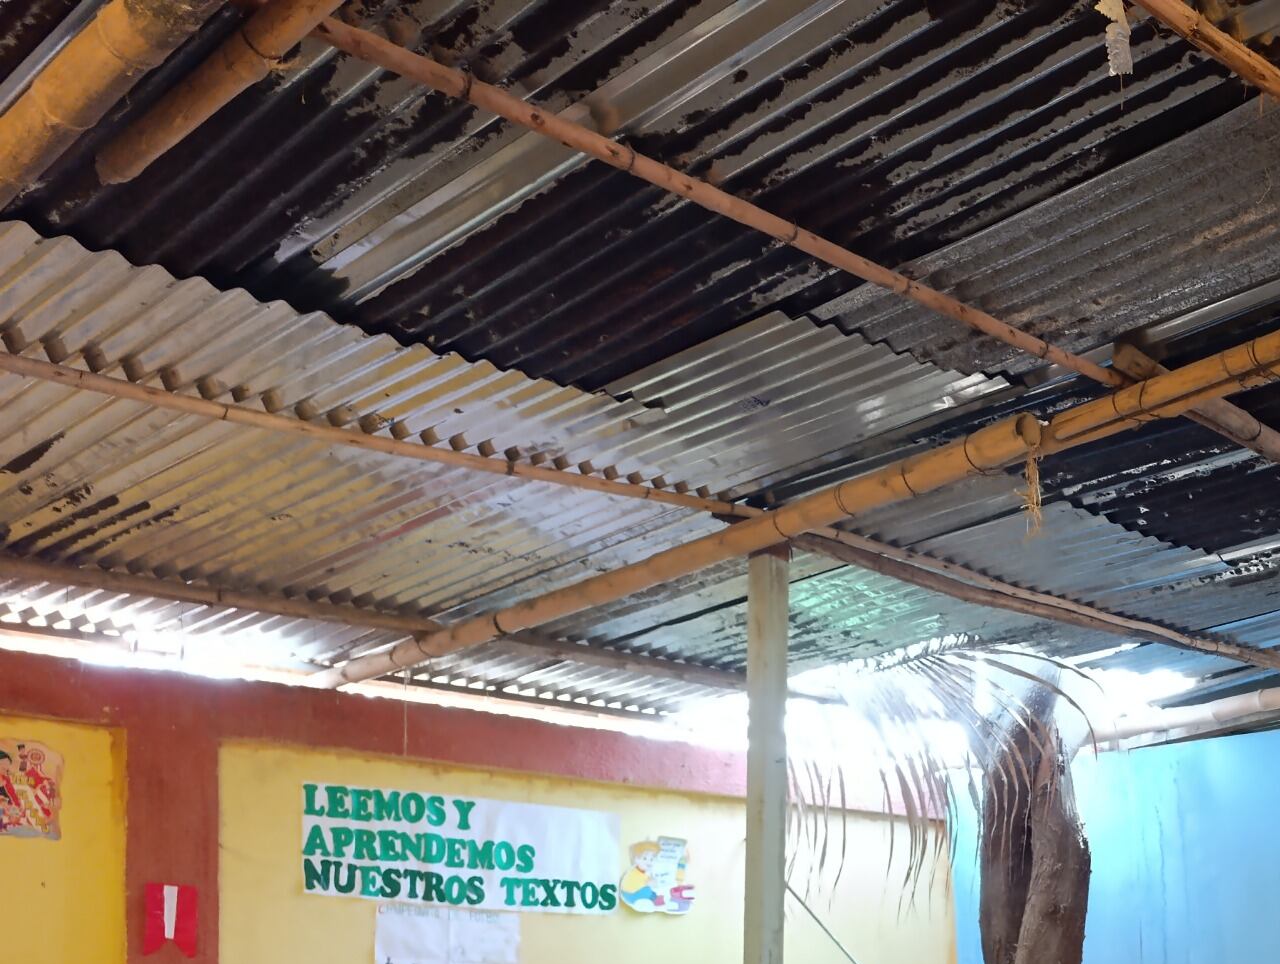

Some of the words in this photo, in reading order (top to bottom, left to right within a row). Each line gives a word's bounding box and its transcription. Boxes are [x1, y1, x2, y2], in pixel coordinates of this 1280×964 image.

[303, 784, 447, 827] LEEMOS
[452, 800, 476, 830] Y
[302, 825, 536, 873] APRENDEMOS
[303, 858, 486, 905] NUESTROS
[499, 876, 618, 911] TEXTOS
